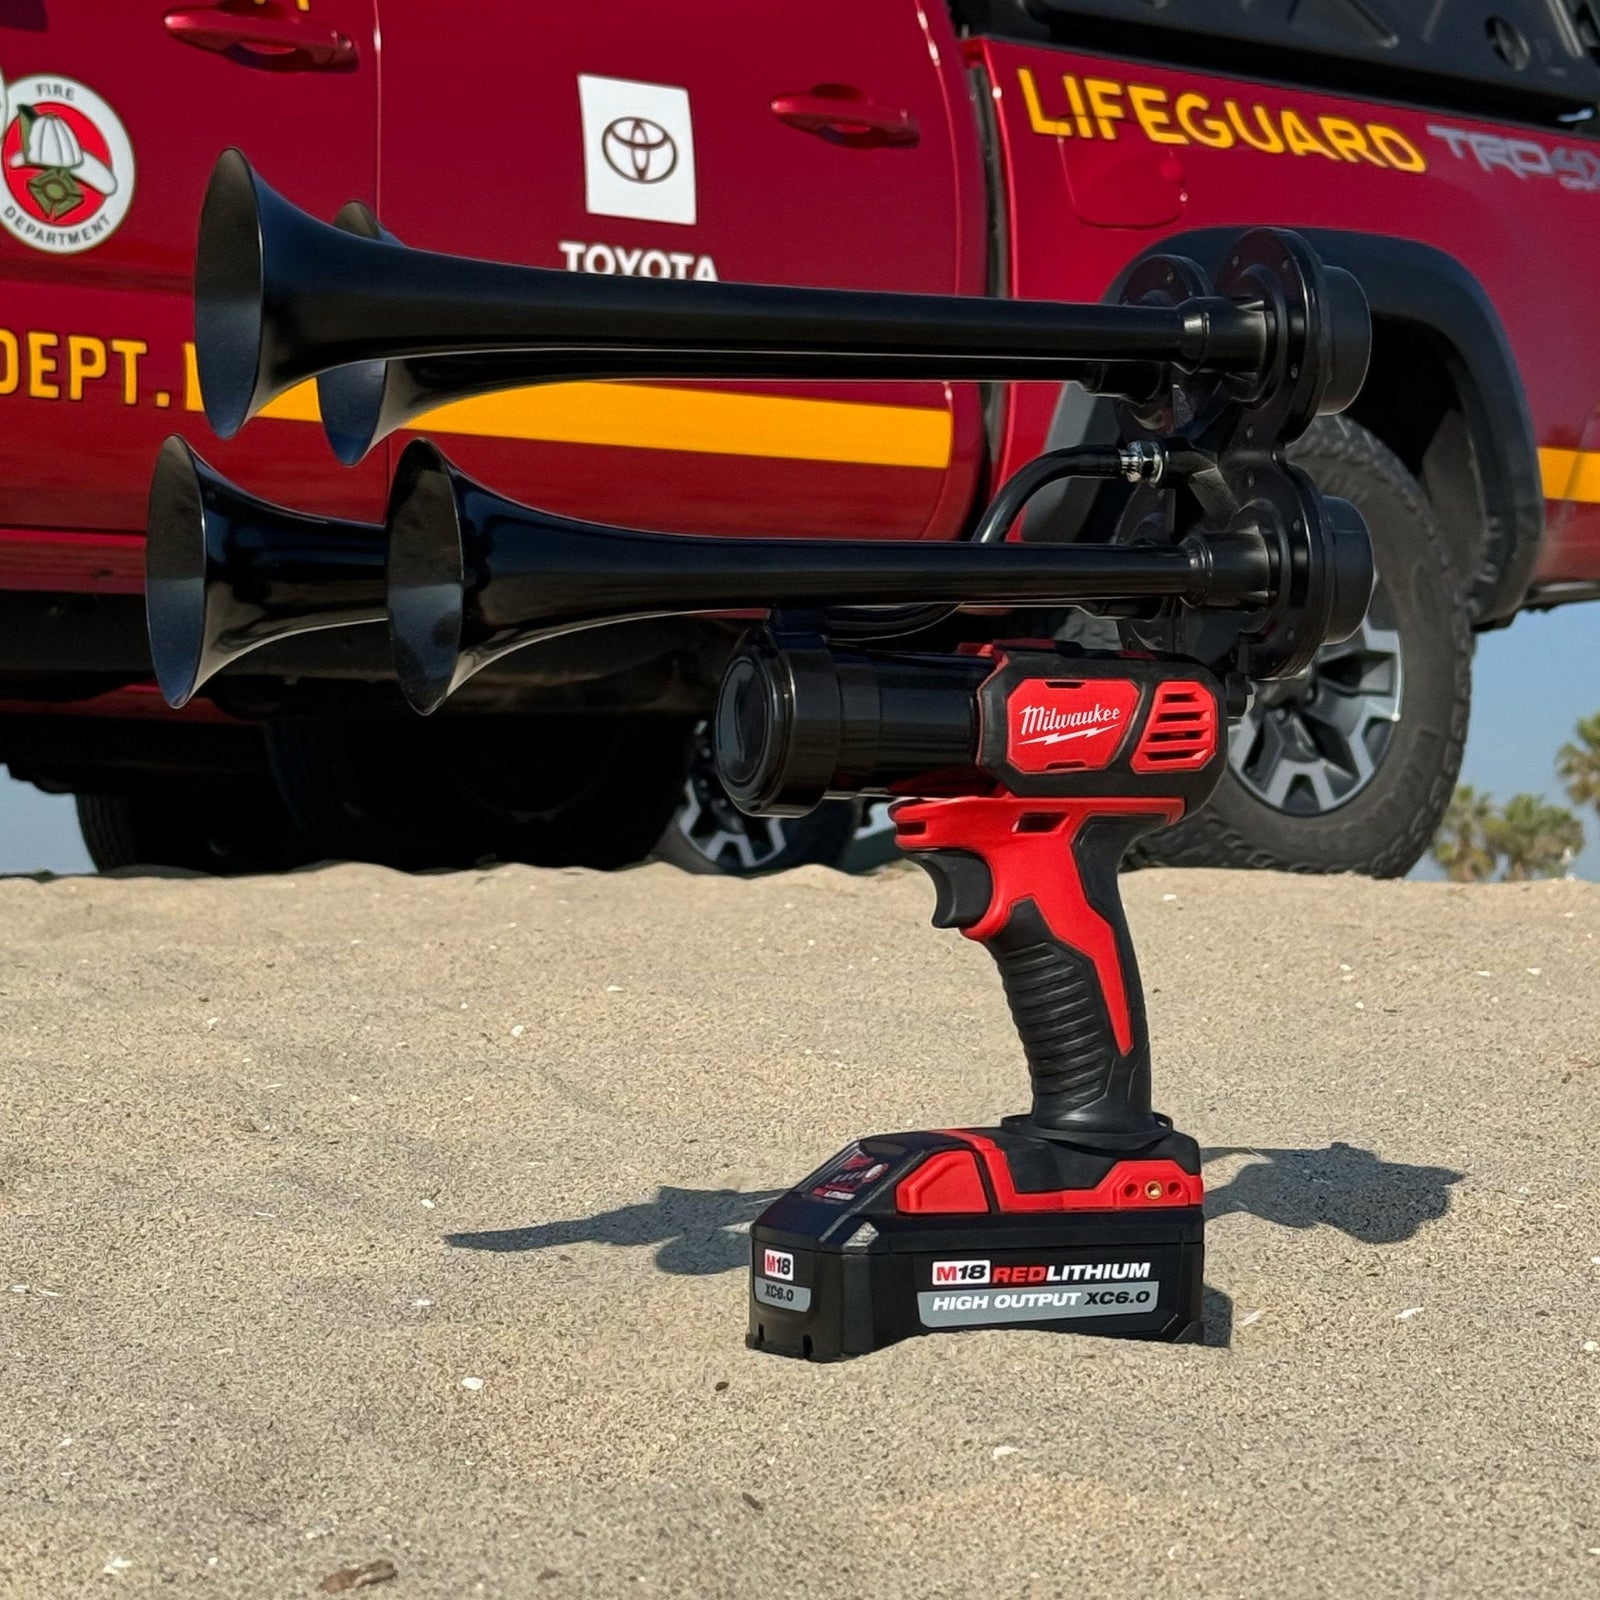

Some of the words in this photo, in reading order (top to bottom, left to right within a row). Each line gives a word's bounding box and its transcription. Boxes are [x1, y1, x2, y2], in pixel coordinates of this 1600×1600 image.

[36, 84, 76, 101] FIRE
[1017, 67, 1427, 174] LIFEGUARD
[3, 206, 111, 246] DEPARTMENT
[558, 241, 719, 282] TOYOTA
[1019, 703, 1121, 736] Milwaukee
[765, 1253, 792, 1276] M18
[936, 1264, 987, 1281] M18
[992, 1262, 1151, 1283] REDLITHIUM
[764, 1283, 795, 1302] XC6.0
[932, 1295, 988, 1311] HIGH
[993, 1291, 1082, 1308] OUTPUT
[1083, 1290, 1151, 1306] XC6.0
